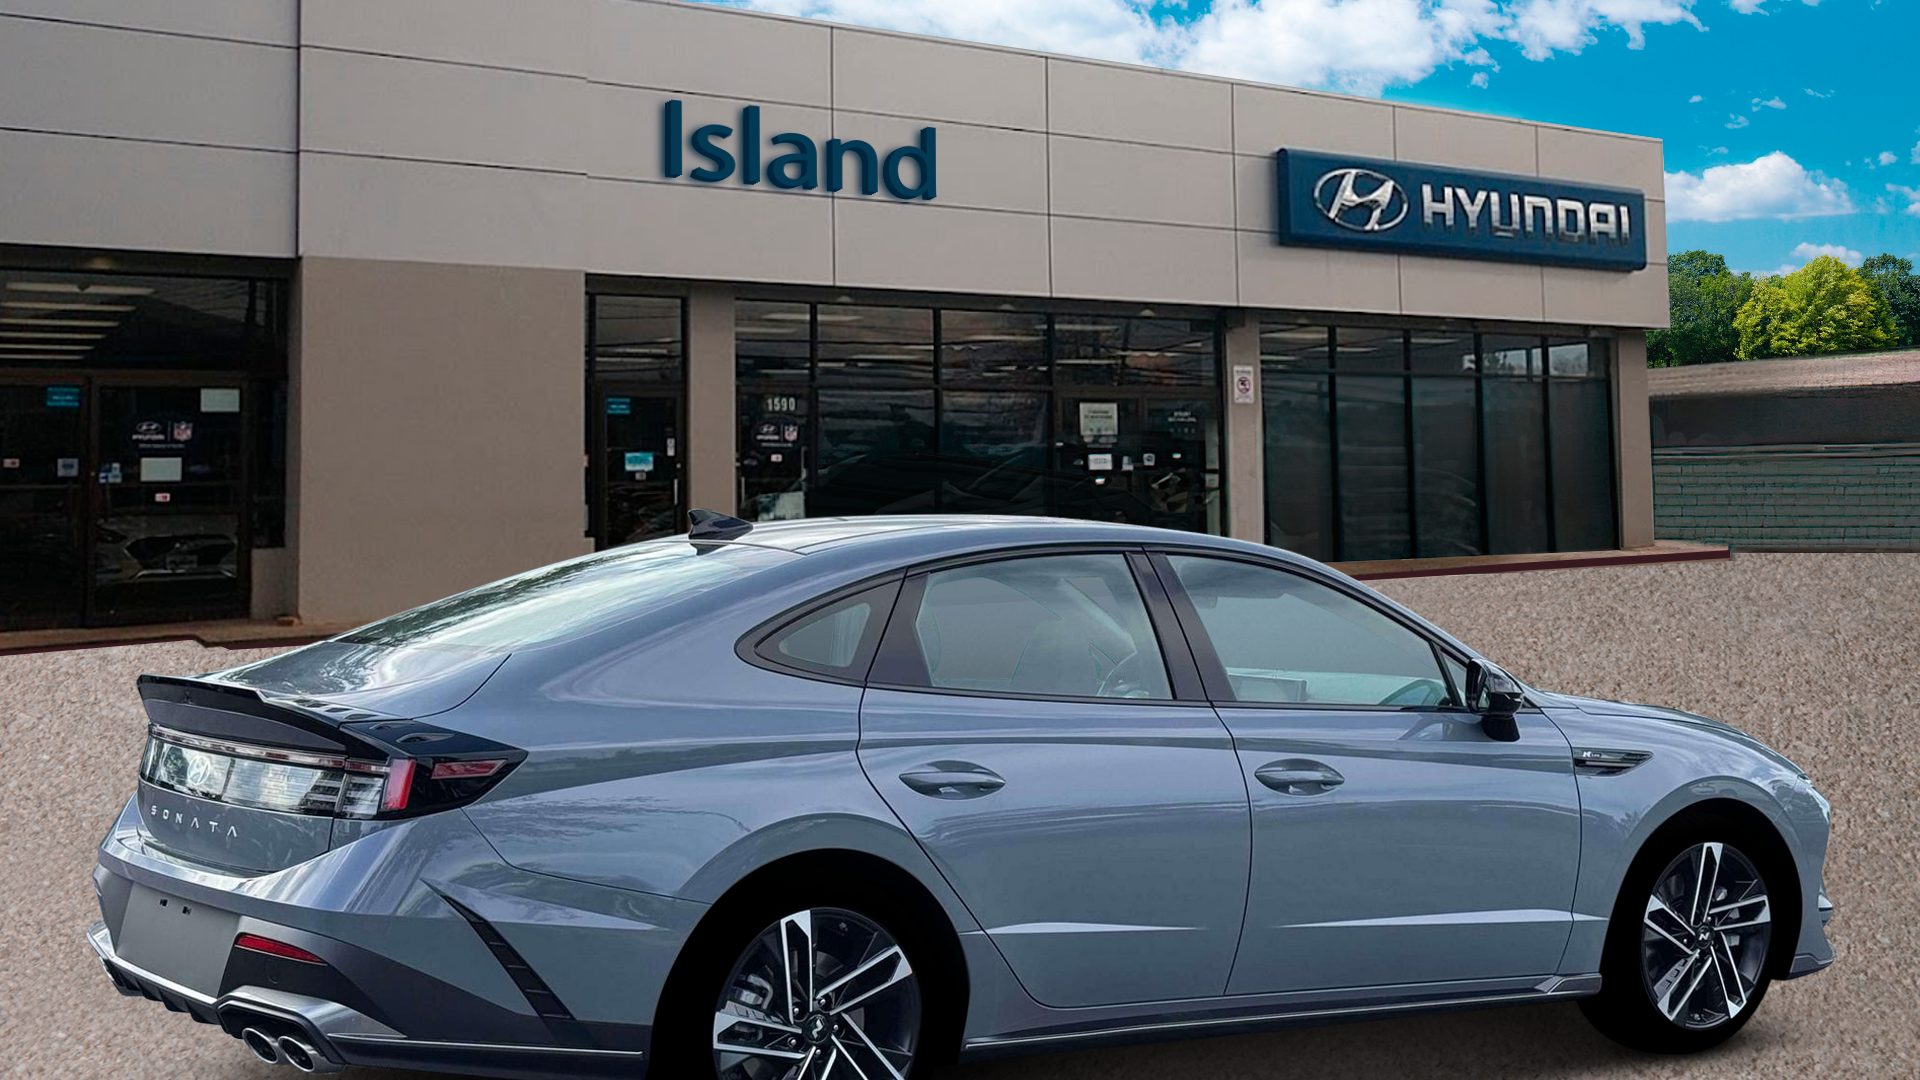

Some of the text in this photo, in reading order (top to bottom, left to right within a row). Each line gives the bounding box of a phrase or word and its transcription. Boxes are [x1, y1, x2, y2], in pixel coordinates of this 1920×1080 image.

[664, 99, 937, 200] Island
[1421, 184, 1630, 243] HYUNDAI
[767, 397, 796, 411] 1590
[150, 804, 238, 838] SONATA
